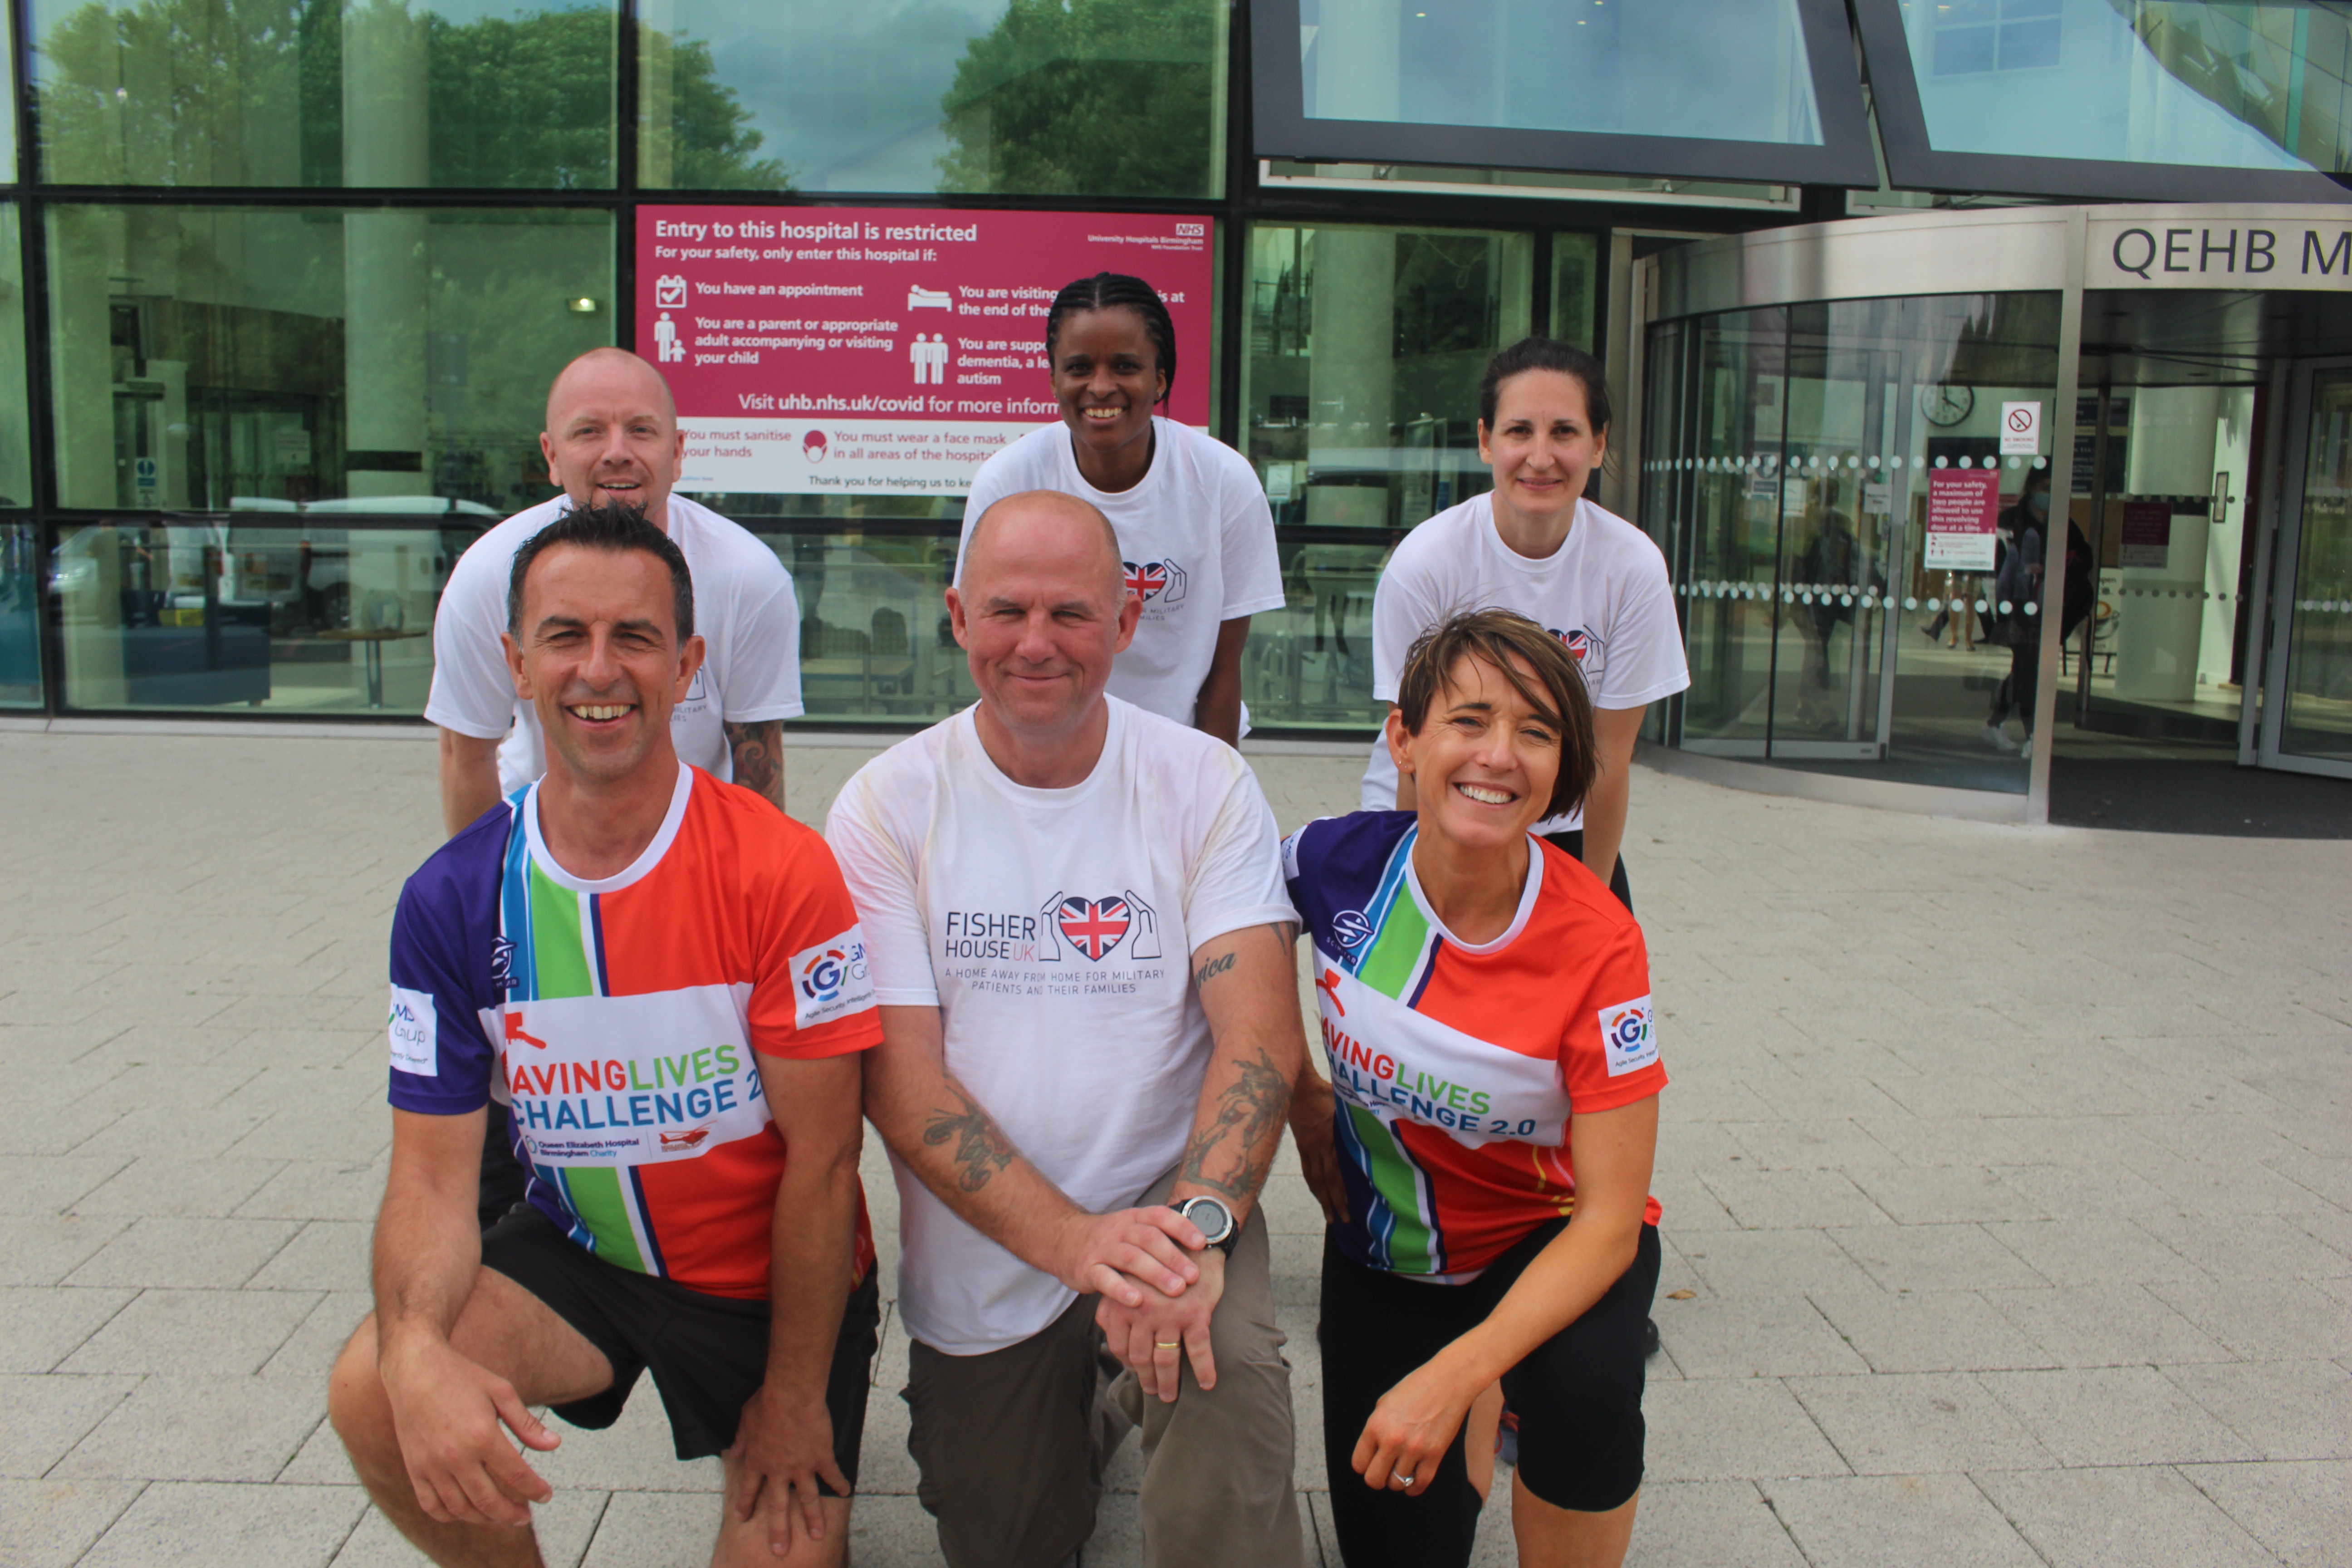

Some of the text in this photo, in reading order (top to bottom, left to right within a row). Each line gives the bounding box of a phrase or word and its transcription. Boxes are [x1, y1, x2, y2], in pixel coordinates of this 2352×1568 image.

[656, 221, 976, 243] Entry to this hospital is restricted
[1178, 225, 1202, 235] NHS
[1088, 235, 1203, 245] University Hospitals Birmingham
[656, 246, 937, 264] For your safety, only enter this hospital if:
[2113, 229, 2276, 279] QEHB
[696, 282, 863, 299] You have an appointment
[958, 285, 984, 298] You
[987, 289, 1008, 298] are
[1011, 287, 1059, 302] visiting
[1171, 292, 1185, 303] at
[958, 303, 1051, 317] the end of the
[695, 317, 898, 333] You are a parent or appropriate
[695, 334, 893, 351] adult accompanying or visiting
[957, 338, 983, 350] You
[986, 340, 1007, 350] are
[695, 351, 759, 366] your child
[957, 355, 1022, 369] dementia,
[1026, 359, 1034, 368] a
[957, 372, 1001, 385] autism
[738, 393, 1059, 414] Visit uhb.nhs.uk/covid for more inform
[684, 431, 792, 441] You must sanitise
[834, 431, 1006, 444] You must wear a face mask
[683, 446, 752, 459] your hands
[834, 448, 844, 459] in
[849, 448, 863, 459] all
[867, 451, 901, 460] areas
[904, 449, 918, 460] of
[921, 449, 941, 460] the
[809, 475, 841, 485] Thank
[844, 478, 864, 488] you
[868, 476, 883, 486] for
[886, 477, 926, 489] helping
[945, 479, 956, 487] to
[1948, 498, 1972, 506] people
[1945, 516, 1979, 524] revolving
[1150, 604, 1184, 613] MILITARY
[946, 911, 1035, 941] FISHER
[946, 968, 951, 977] A
[956, 968, 986, 978] HOME
[991, 970, 1019, 980] AWAY
[1051, 972, 1080, 982] HOME
[1086, 971, 1107, 981] FOR
[1112, 969, 1165, 980] MILITARY
[971, 982, 1021, 995] PATIENTS
[1048, 985, 1078, 995] THEIR
[1084, 983, 1136, 994] FAMILIES
[805, 1010, 821, 1019] Agile
[1490, 1119, 1536, 1136] 2.0
[605, 1138, 639, 1148] Hospital
[540, 1149, 617, 1158] Birmingham Charity
